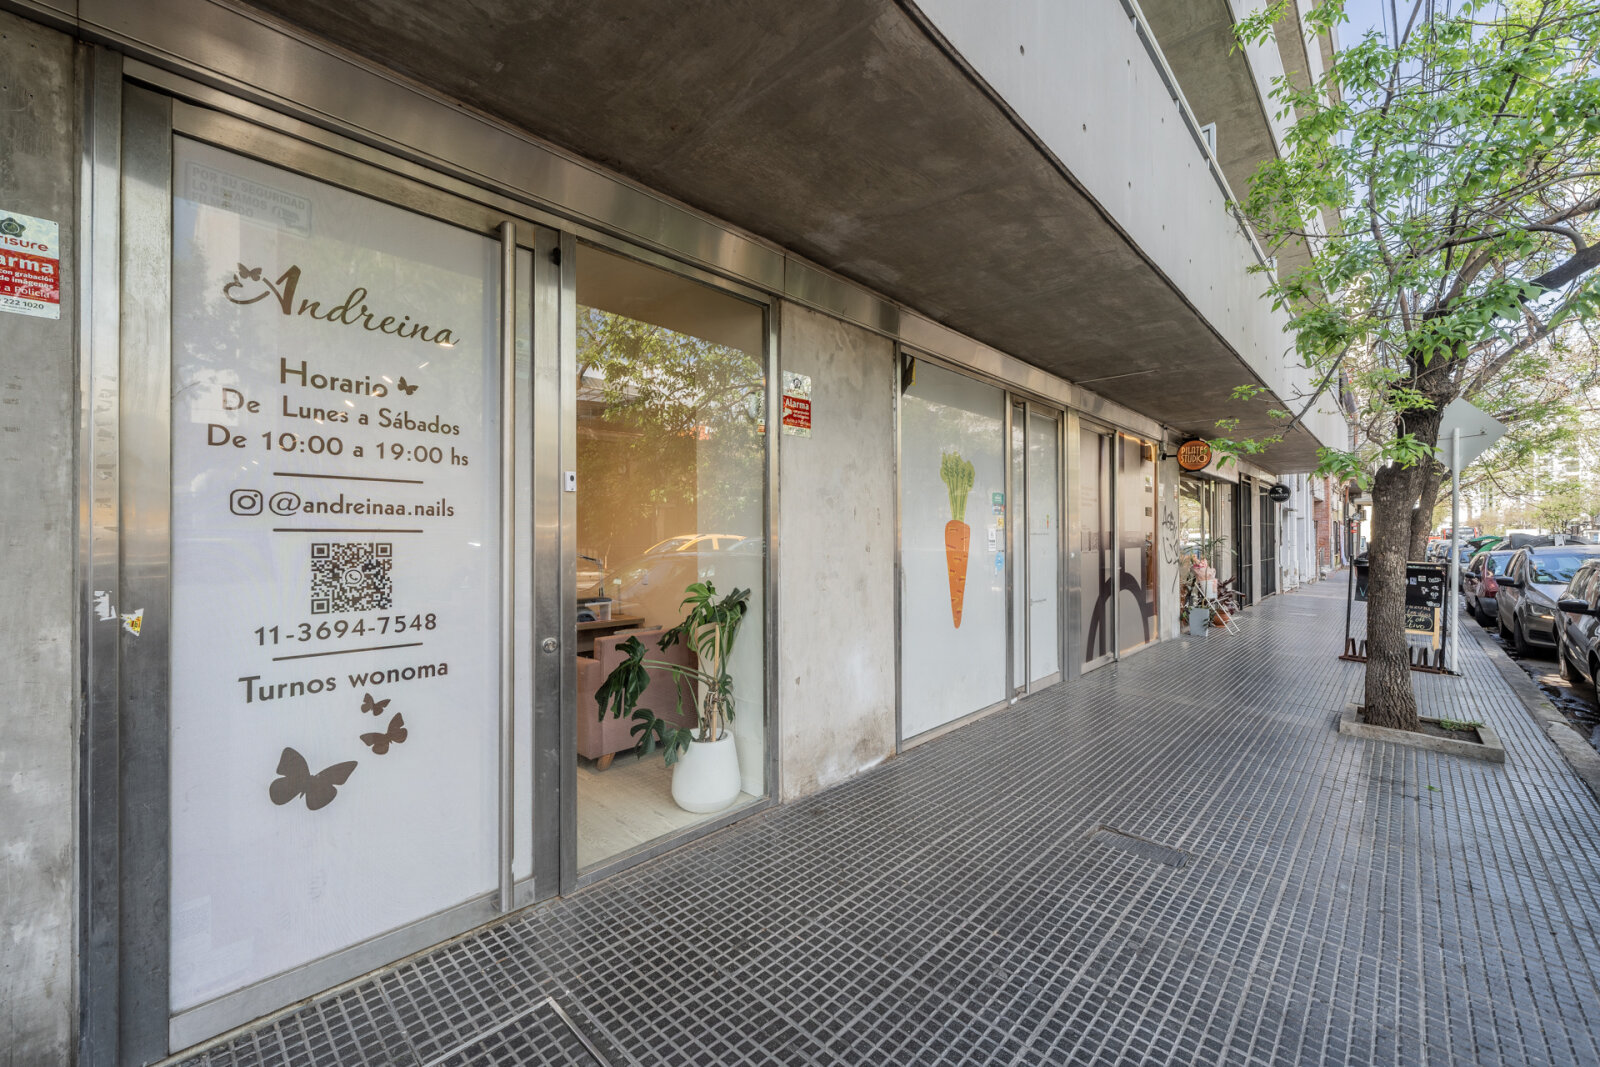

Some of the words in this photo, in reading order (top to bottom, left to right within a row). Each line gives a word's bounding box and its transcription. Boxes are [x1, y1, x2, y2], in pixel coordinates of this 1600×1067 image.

[192, 167, 217, 184] POR
[240, 182, 305, 210] SEGURIDAD
[14, 271, 54, 283] grabación
[22, 301, 44, 310] 1020
[223, 264, 460, 346] Andreina
[280, 357, 389, 398] Horario
[222, 387, 261, 414] De
[282, 395, 349, 423] Lunes
[358, 413, 369, 426] a
[378, 407, 460, 436] Sábados
[785, 398, 809, 410] Alarma
[207, 423, 248, 449] De
[261, 431, 344, 456] 10:00
[352, 445, 364, 458] a
[376, 442, 443, 464] 19:00
[451, 447, 469, 466] hs
[1181, 454, 1208, 463] STUDIO
[268, 491, 455, 517] @andreinaa.nails
[254, 613, 437, 646] 11-3694-7548
[237, 675, 337, 704] Turnos
[348, 661, 449, 689] wonoma
